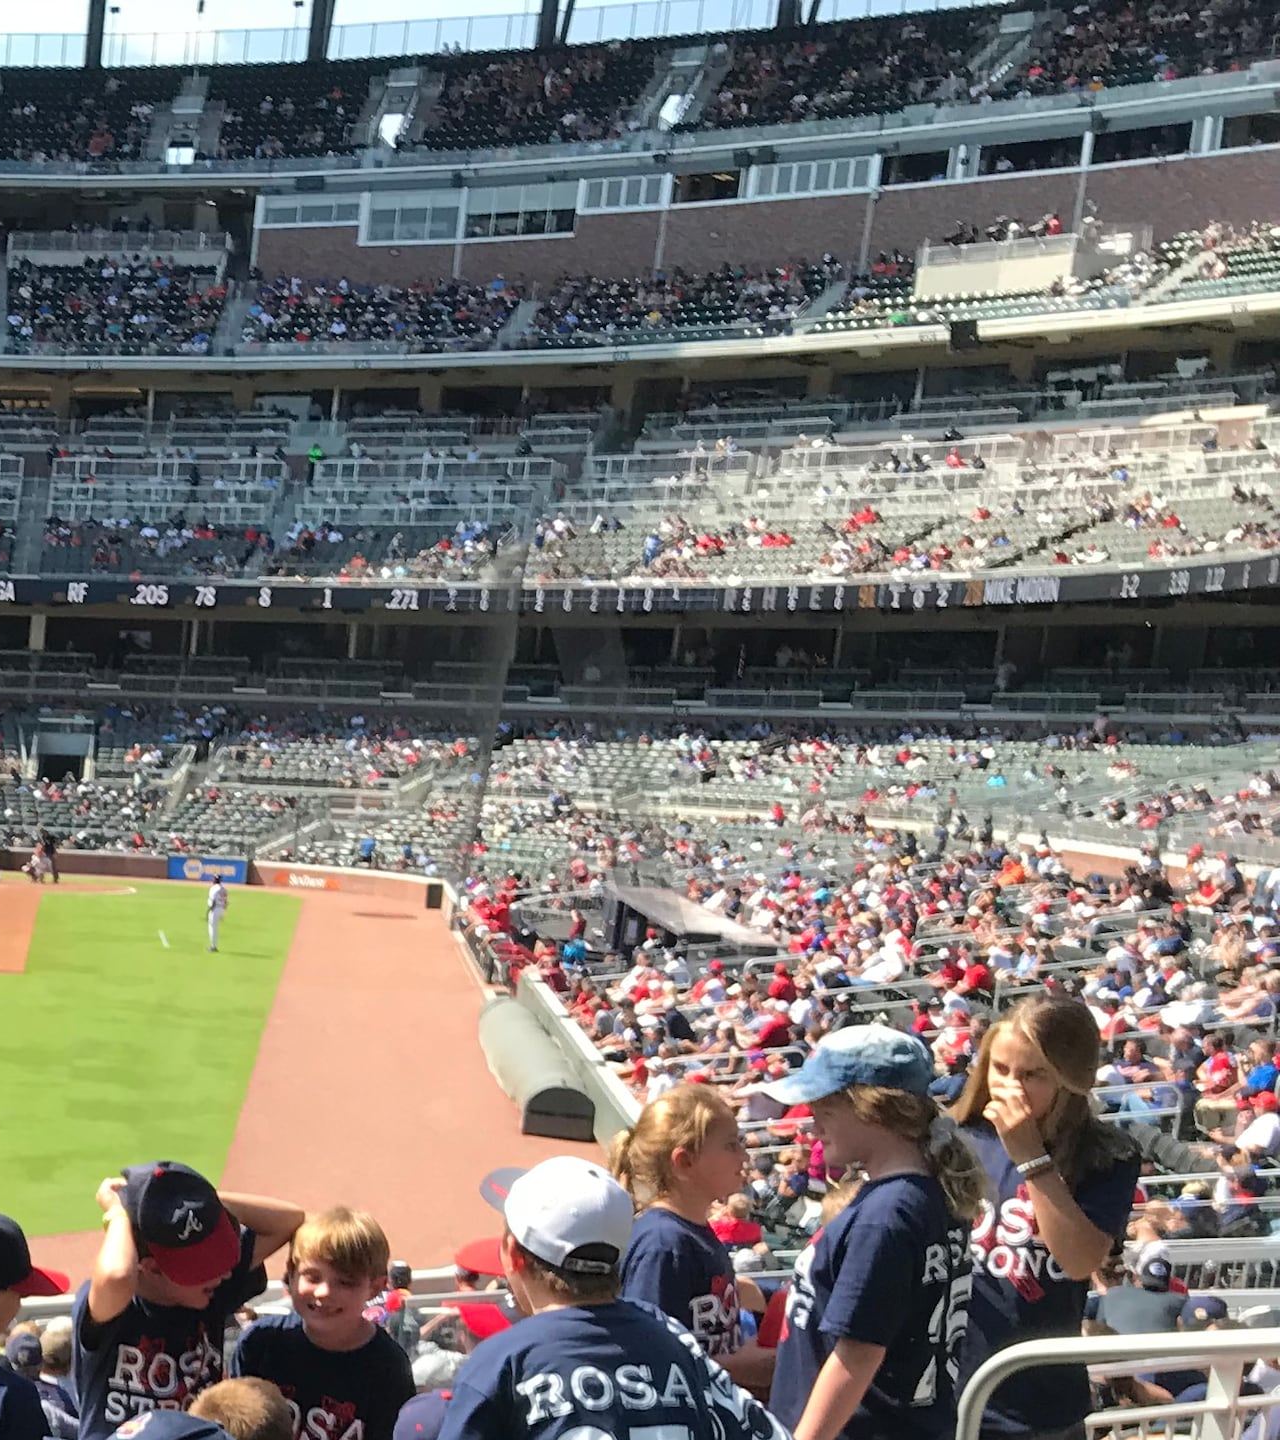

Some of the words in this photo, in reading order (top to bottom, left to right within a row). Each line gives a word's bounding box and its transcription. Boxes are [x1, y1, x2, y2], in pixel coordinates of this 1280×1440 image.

[67, 582, 89, 604] RF
[130, 584, 169, 606] .205
[194, 586, 217, 607] 78
[258, 587, 272, 608] 8
[322, 588, 333, 609] 1
[385, 588, 420, 611] .271
[177, 1209, 203, 1241] A
[515, 1363, 696, 1426] ROSA
